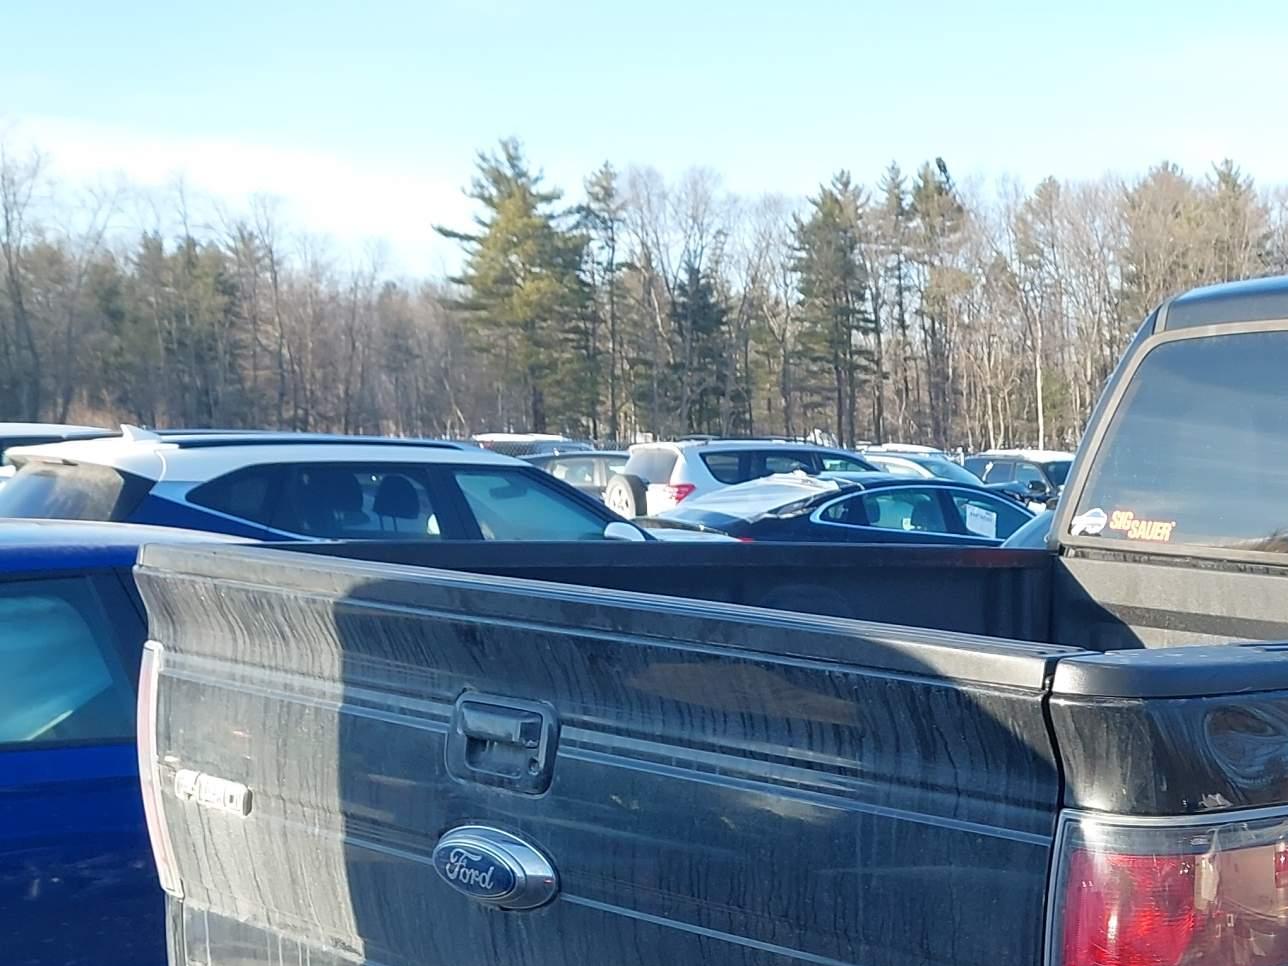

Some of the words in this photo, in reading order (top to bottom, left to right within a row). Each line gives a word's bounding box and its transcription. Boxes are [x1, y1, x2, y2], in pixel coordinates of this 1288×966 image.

[1109, 510, 1134, 530] SIG
[1127, 519, 1172, 542] SAUER
[445, 848, 495, 889] Ford
